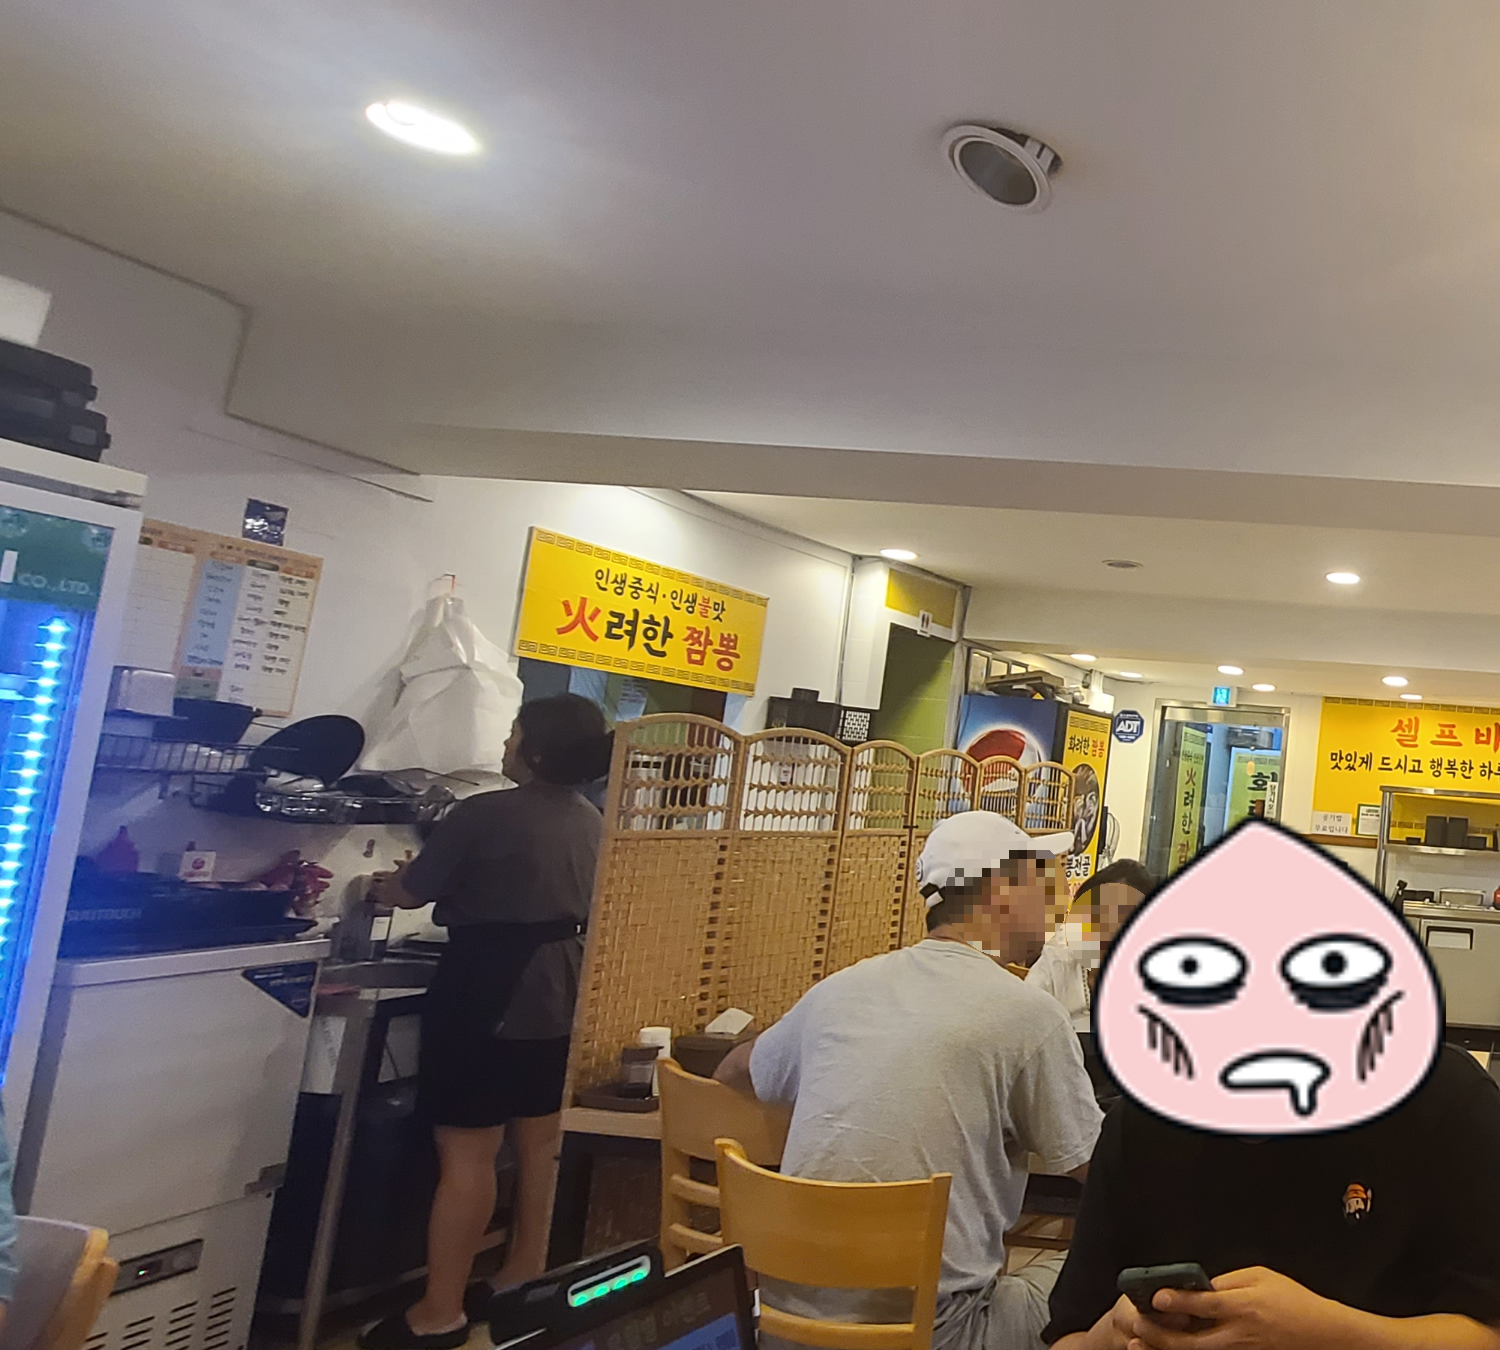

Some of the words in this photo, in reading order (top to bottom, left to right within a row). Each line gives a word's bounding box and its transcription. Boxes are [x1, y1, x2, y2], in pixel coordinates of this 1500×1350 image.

[556, 596, 673, 657] 火려한
[683, 626, 741, 672] 짬뽕
[1115, 720, 1140, 733] ADT
[1068, 734, 1090, 758] 화려한
[1092, 737, 1105, 758] 짬뽕
[1330, 750, 1373, 772] 맛있게
[1377, 754, 1423, 775] 드시고
[1429, 757, 1475, 779] 행복한
[1314, 824, 1348, 834] 무료입니다
